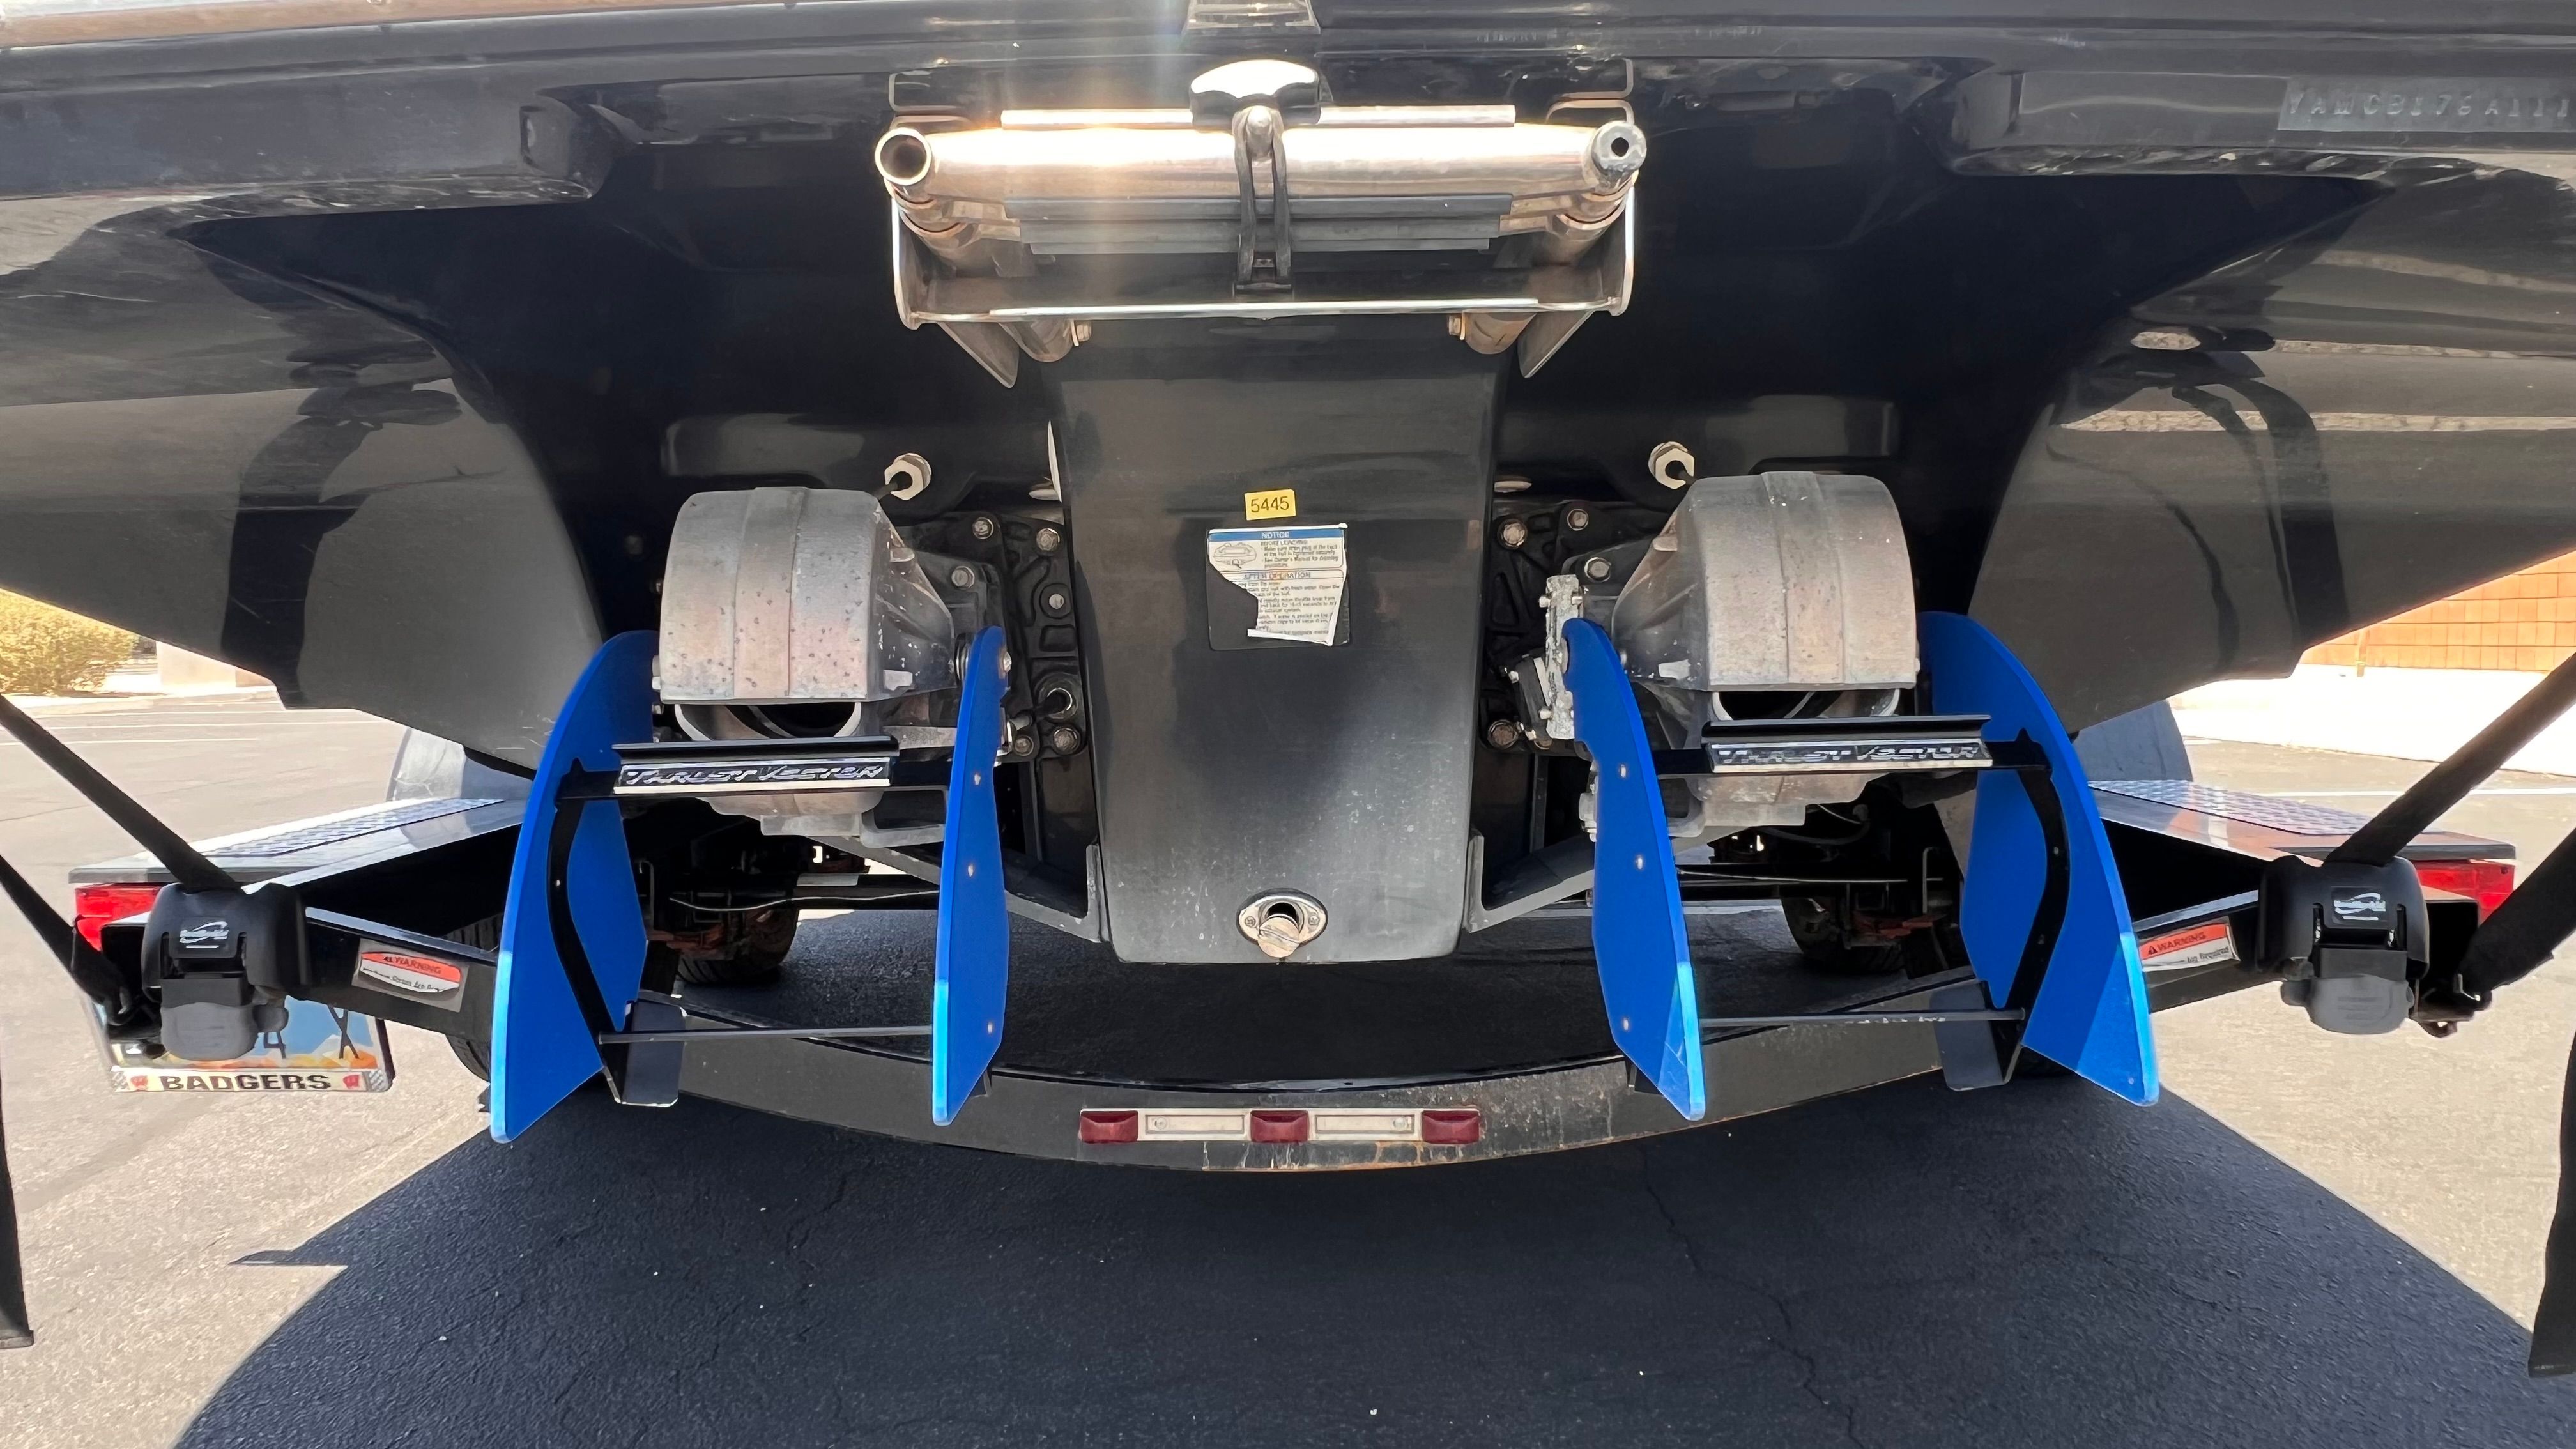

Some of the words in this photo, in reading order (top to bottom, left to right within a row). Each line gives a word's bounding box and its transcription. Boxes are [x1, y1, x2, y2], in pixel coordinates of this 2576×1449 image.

[1250, 496, 1290, 512] 5445
[2158, 931, 2207, 951] WARNING
[394, 956, 442, 974] WARNING
[158, 1073, 332, 1091] BADGERS
